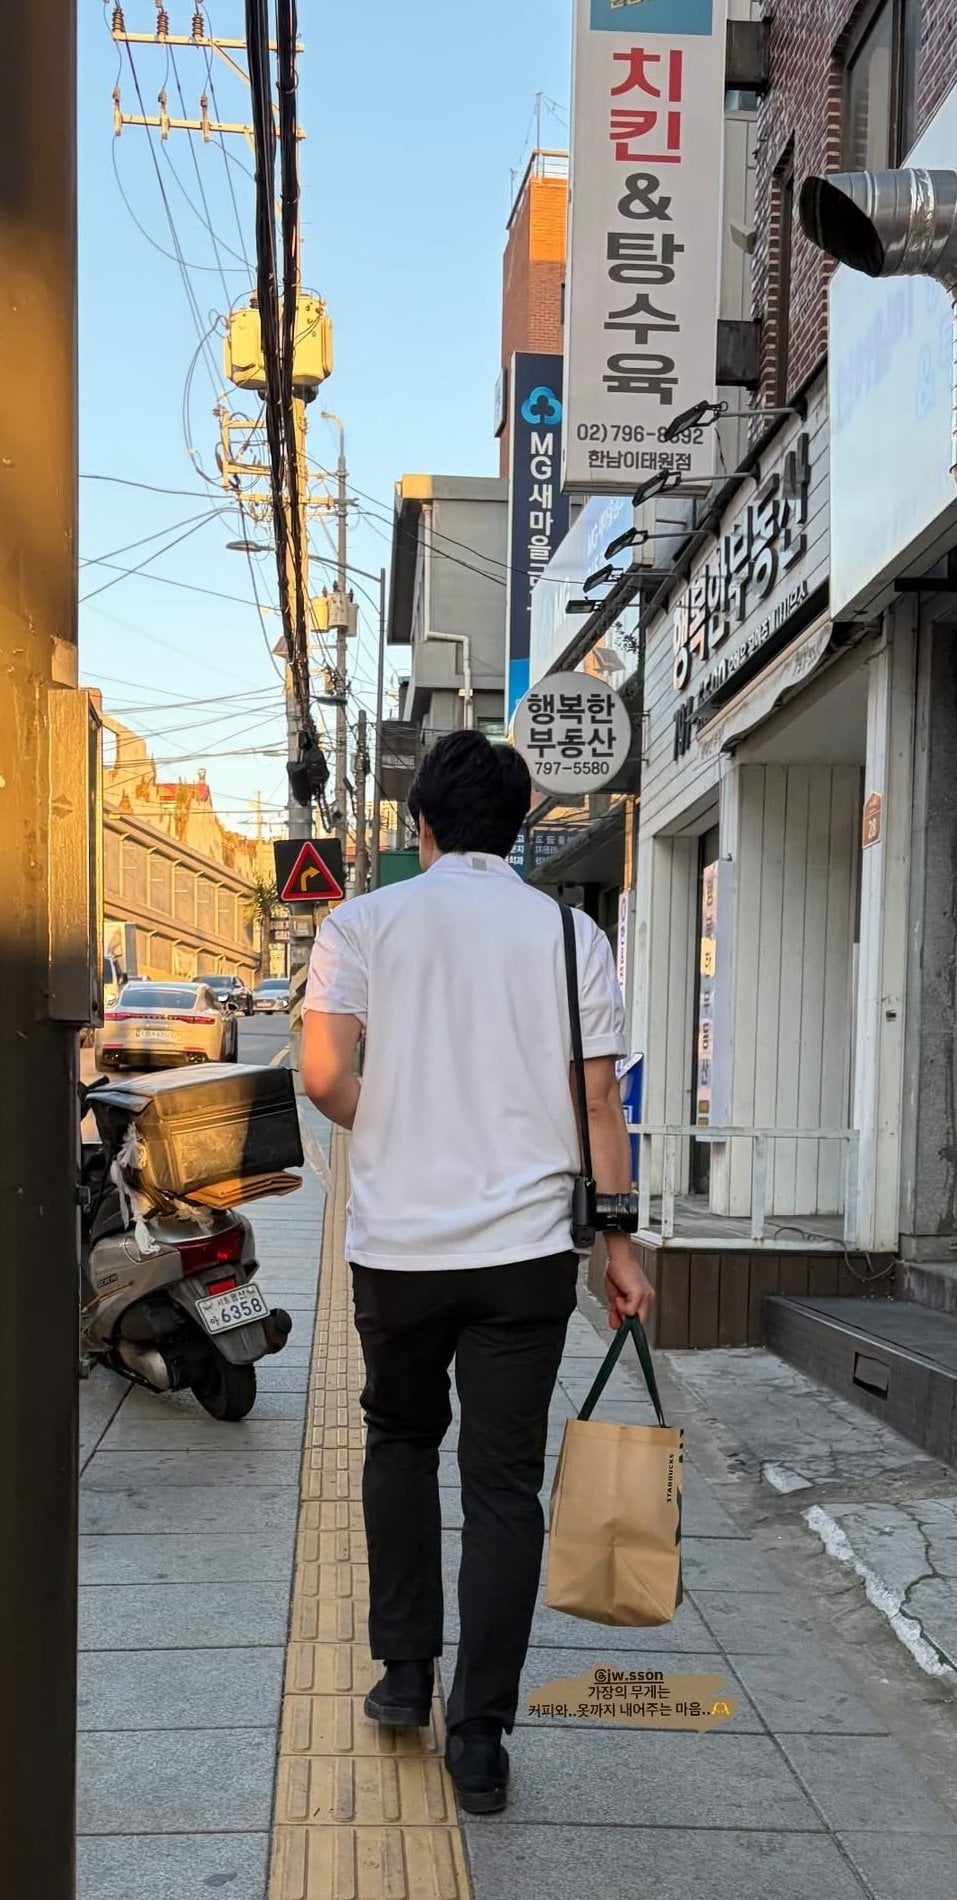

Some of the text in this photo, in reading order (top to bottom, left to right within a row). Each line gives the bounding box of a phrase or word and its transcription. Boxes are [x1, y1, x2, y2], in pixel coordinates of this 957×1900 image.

[601, 47, 685, 406] 치킨&탕수육
[588, 449, 692, 472] 한남이태원점
[527, 431, 554, 611] MG새마을금
[527, 694, 616, 725] 행복한
[527, 728, 617, 759] 부동산
[534, 761, 610, 775] 797-5580
[221, 1297, 263, 1323] 6358
